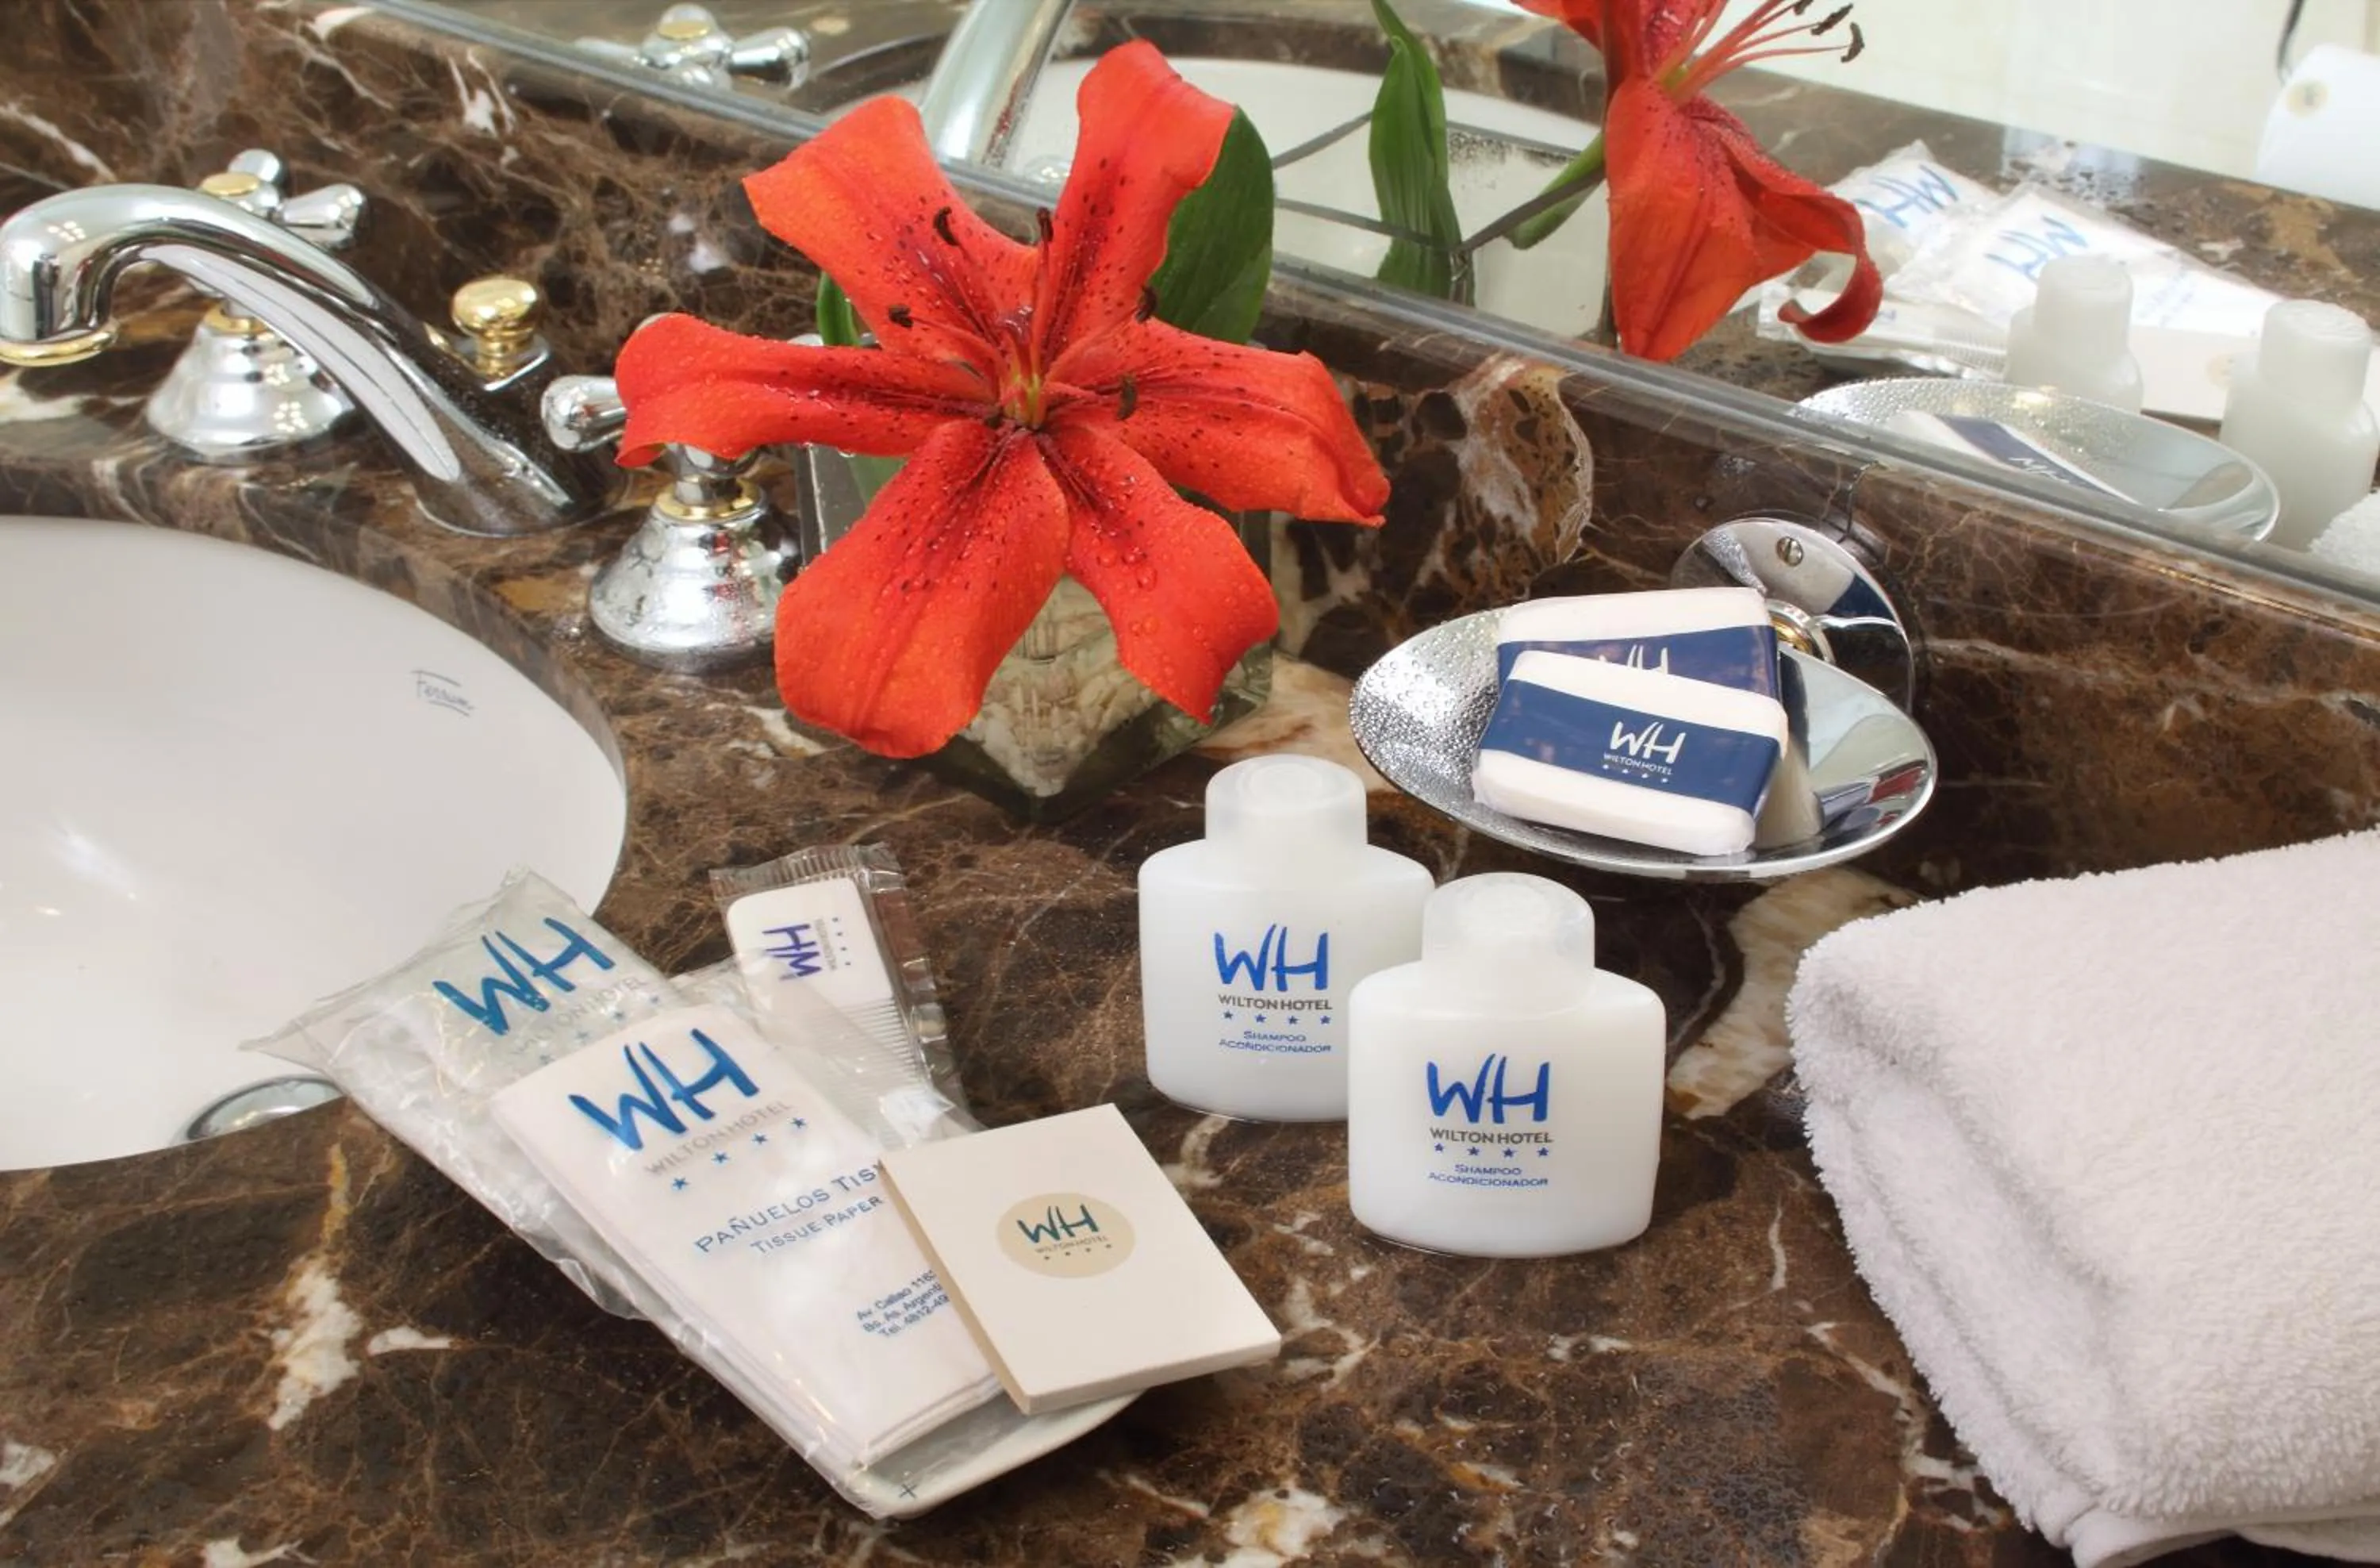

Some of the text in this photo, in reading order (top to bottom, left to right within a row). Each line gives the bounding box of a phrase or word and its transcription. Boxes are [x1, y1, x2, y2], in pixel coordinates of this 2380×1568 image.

[1610, 721, 1686, 764] WH
[432, 917, 616, 1036] WH
[1213, 923, 1329, 992] WH
[1219, 993, 1333, 1011] WILTON HOTEL
[1243, 1031, 1307, 1043] SHAMPOO
[568, 1028, 759, 1151] WH
[1427, 1053, 1550, 1124] WH
[1429, 1127, 1554, 1145] WILTON HOTEL
[1428, 1172, 1549, 1187] ACONDICIONADOR
[1455, 1164, 1522, 1176] SHAMPOO
[694, 1188, 831, 1253] PAÑUELOS
[750, 1195, 885, 1255] TISSUE PAPER
[1016, 1203, 1100, 1243] WH
